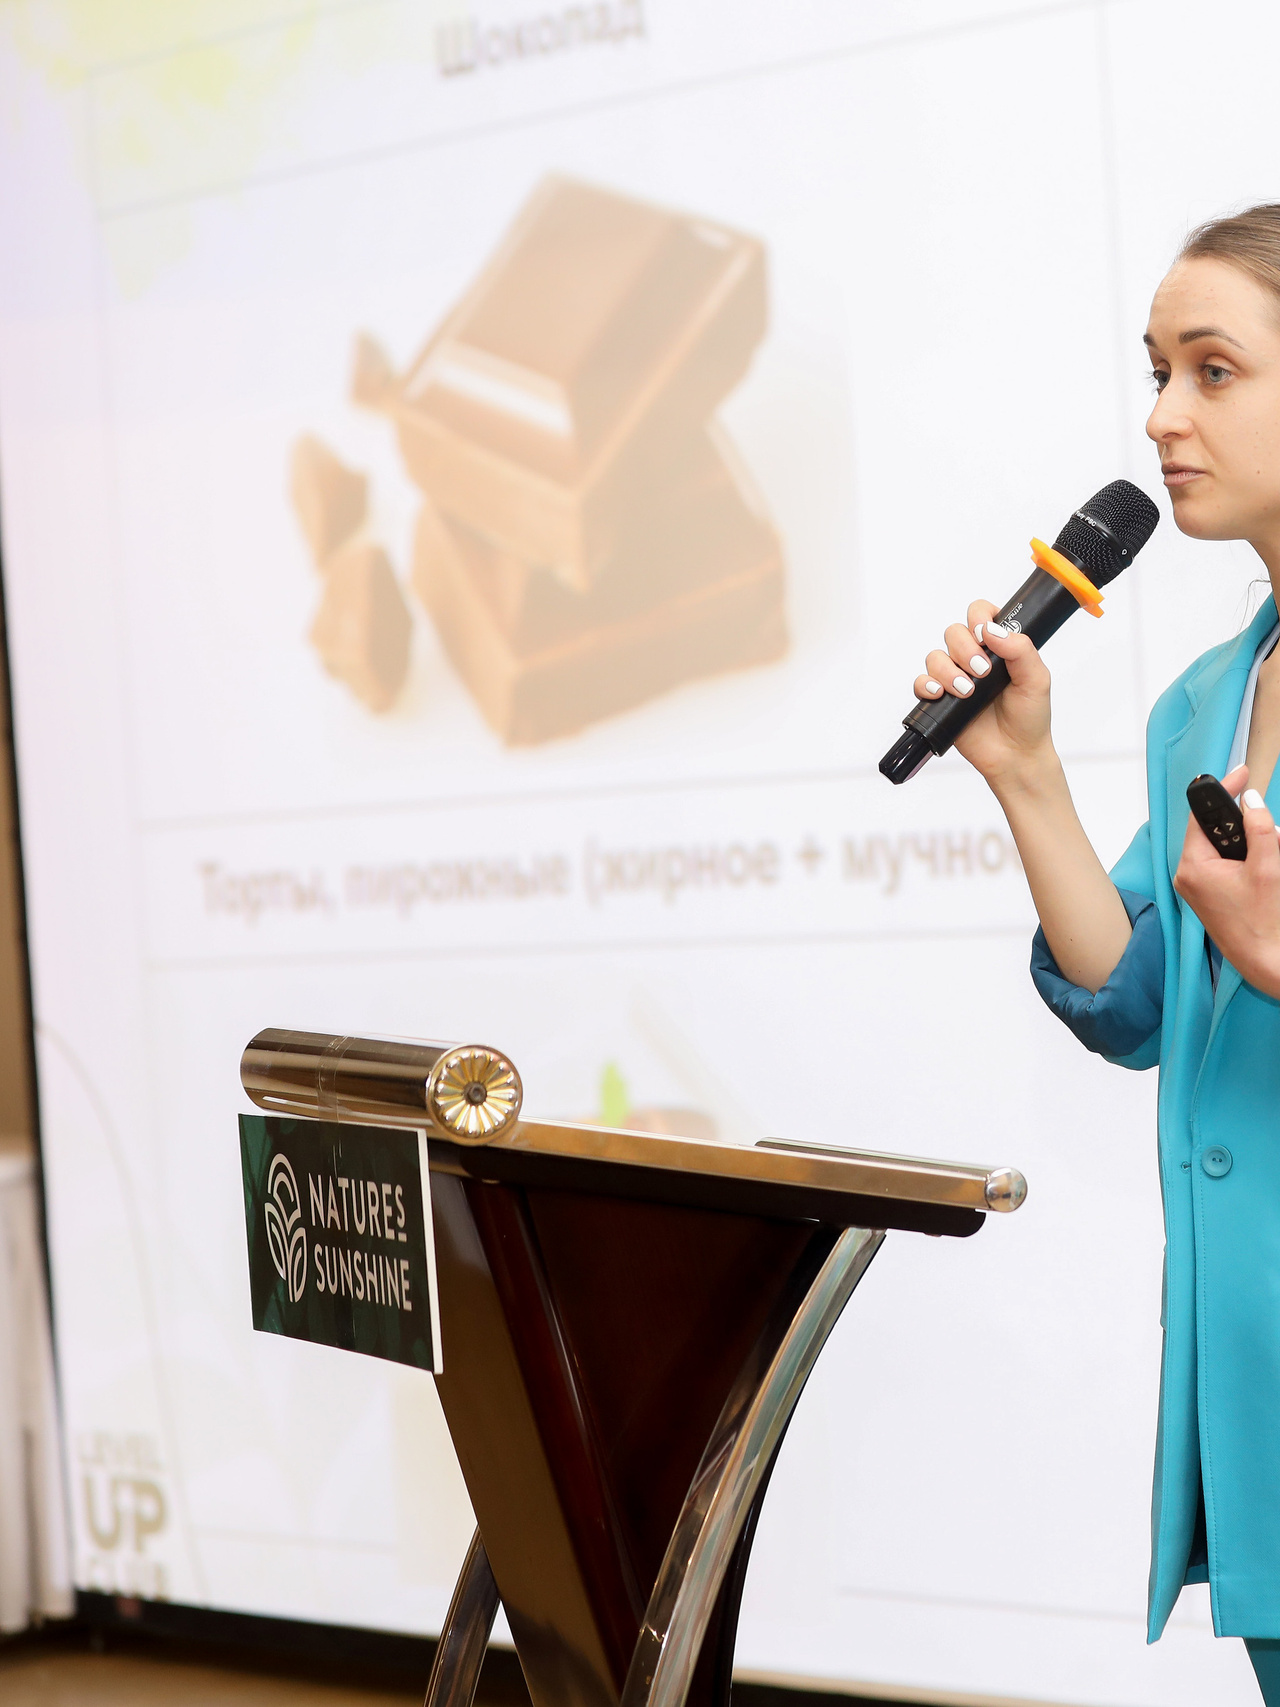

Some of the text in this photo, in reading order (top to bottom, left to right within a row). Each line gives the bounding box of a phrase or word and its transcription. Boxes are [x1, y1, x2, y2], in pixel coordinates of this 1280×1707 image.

[584, 835, 778, 904] (жирное
[796, 839, 823, 874] +
[308, 1172, 407, 1242] NATURES
[314, 1243, 412, 1312] SUNSHINE
[84, 1474, 168, 1552] UP
